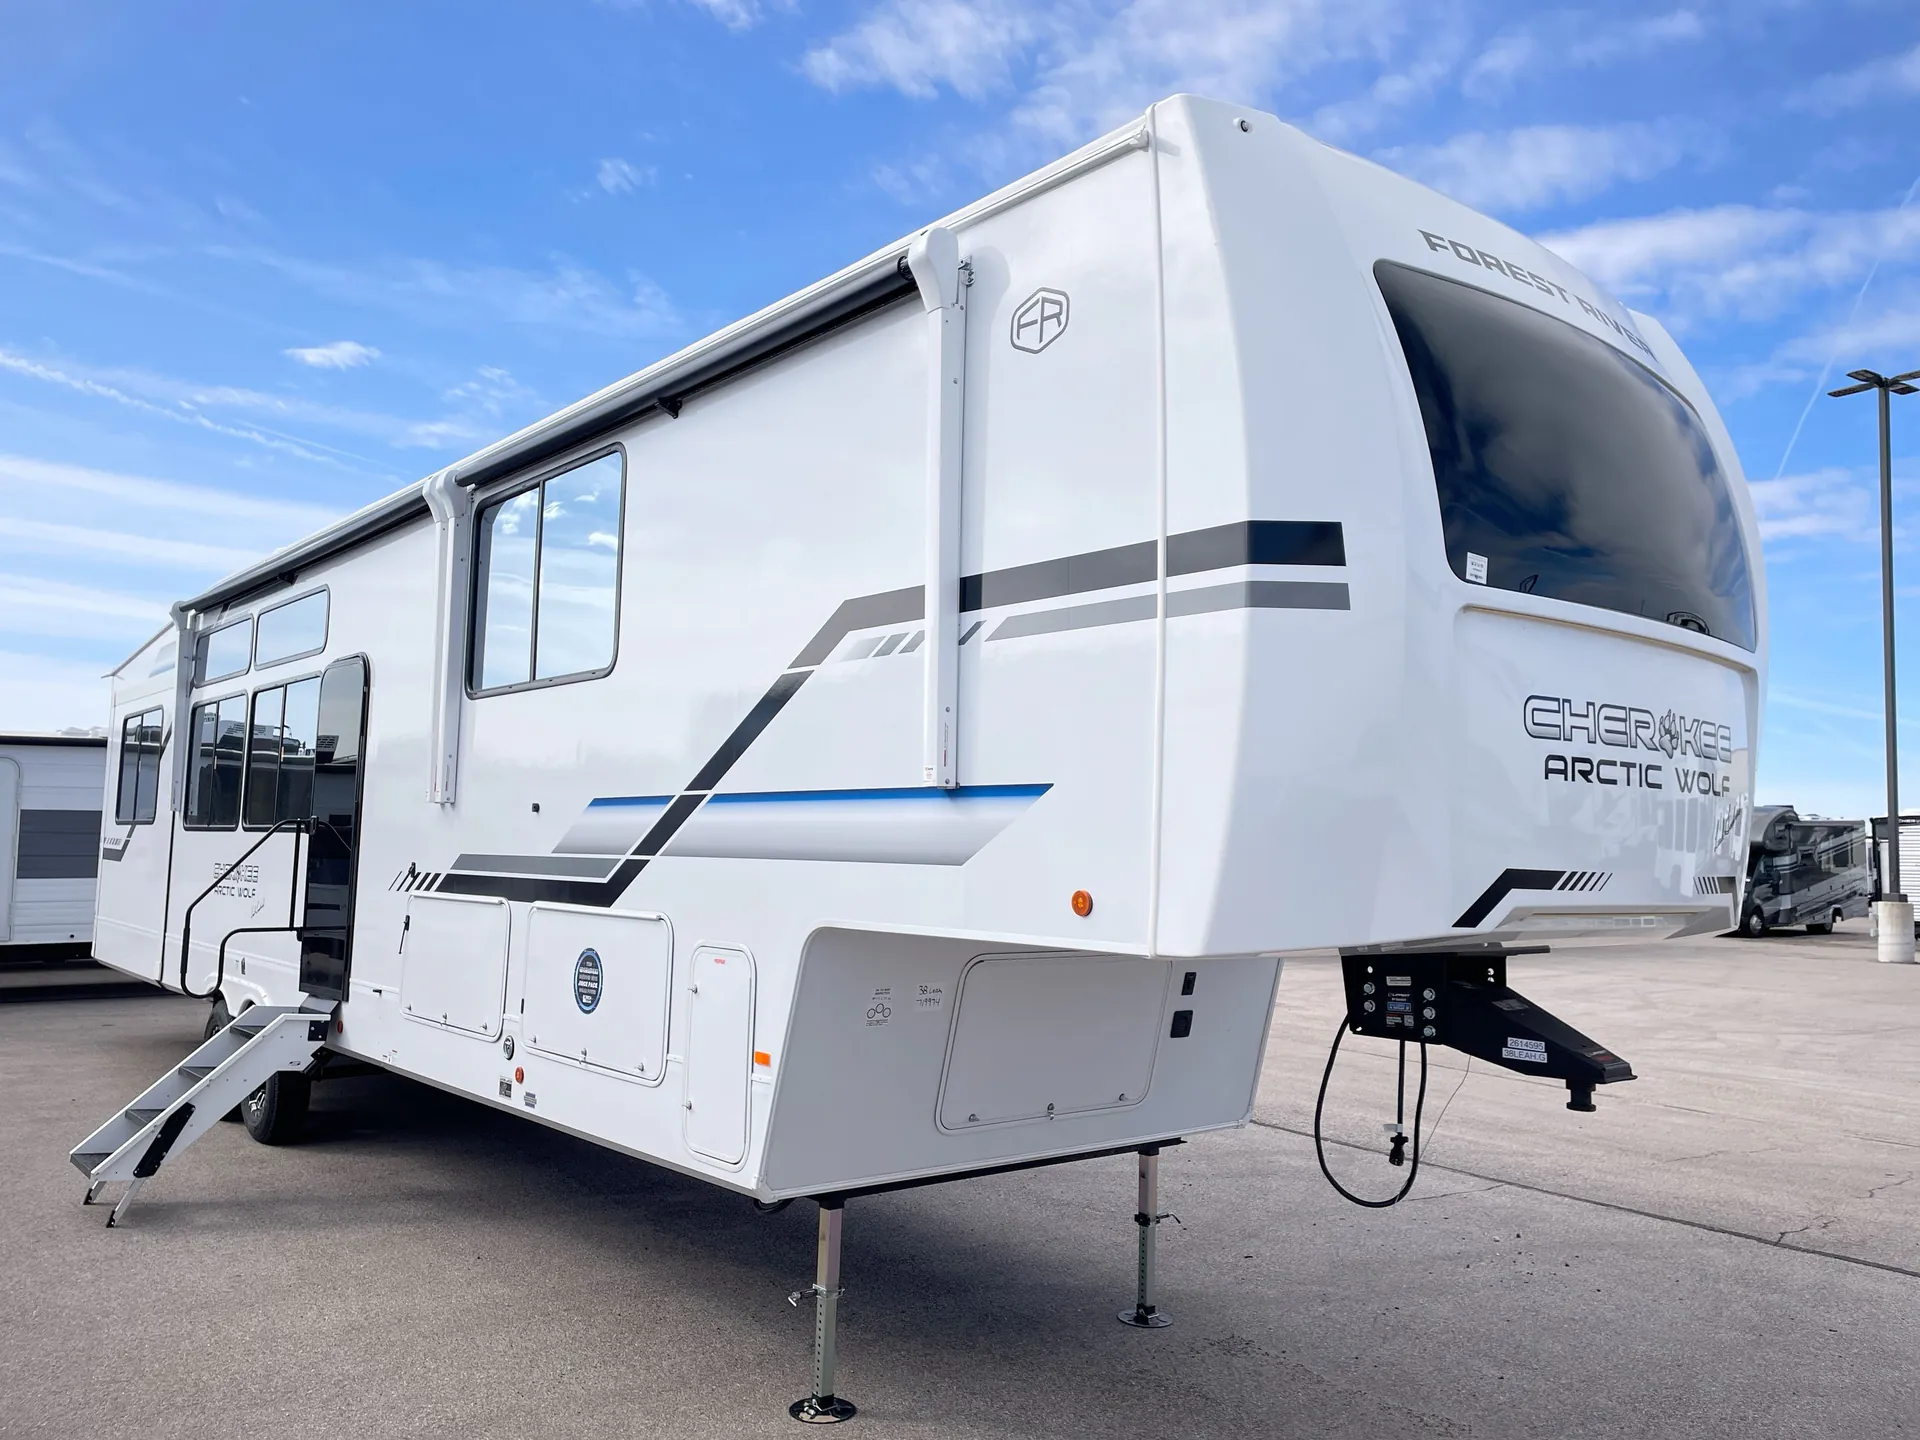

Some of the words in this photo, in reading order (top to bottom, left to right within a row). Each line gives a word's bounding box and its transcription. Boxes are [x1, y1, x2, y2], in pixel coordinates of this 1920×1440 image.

[1417, 228, 1570, 304] FOREST
[1574, 294, 1659, 363] RIVER
[1544, 754, 1663, 790] ARCTIC
[1674, 767, 1731, 798] WOLF
[237, 887, 256, 899] WOLF
[919, 985, 928, 995] 38
[1509, 1038, 1544, 1051] 2614595
